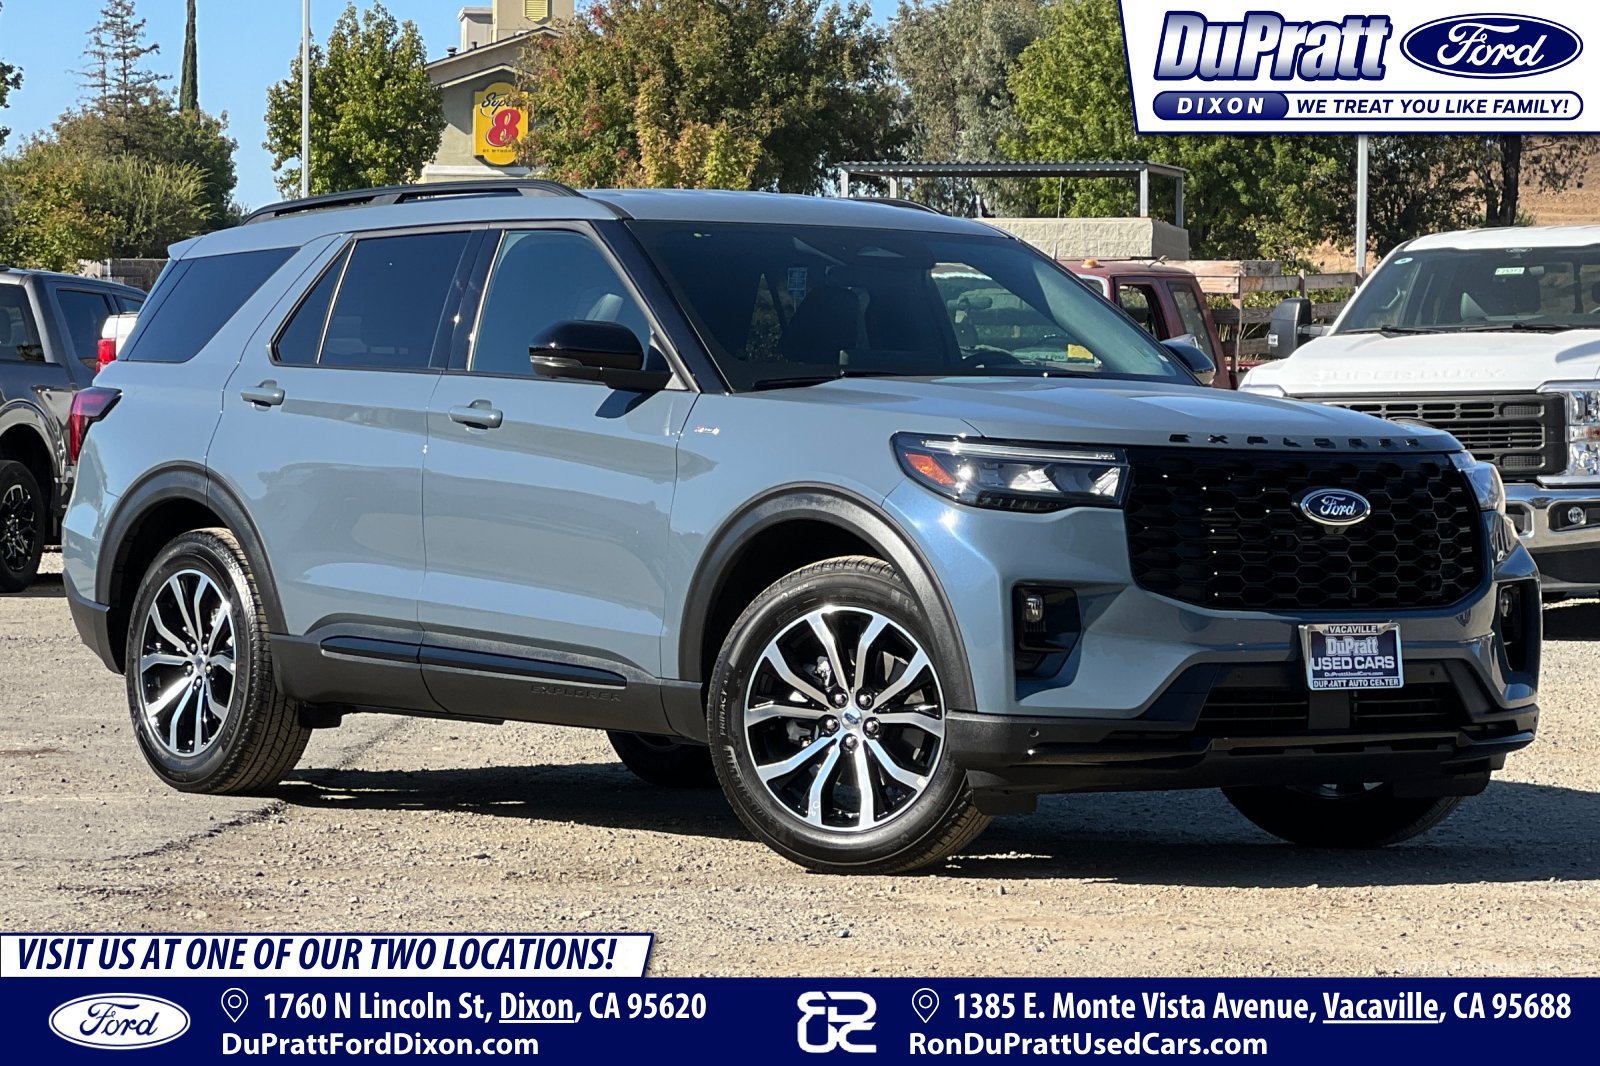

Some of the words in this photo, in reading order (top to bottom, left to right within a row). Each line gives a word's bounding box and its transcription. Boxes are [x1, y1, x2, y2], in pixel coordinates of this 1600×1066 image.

[486, 108, 521, 147] 8
[1320, 495, 1357, 516] Ford
[1329, 625, 1377, 634] VACAVILLE
[1325, 636, 1378, 656] DuPratt
[1311, 657, 1352, 670] USED
[1354, 656, 1395, 669] CARS
[1348, 679, 1368, 687] AUTO
[530, 684, 621, 702] EXPLORER
